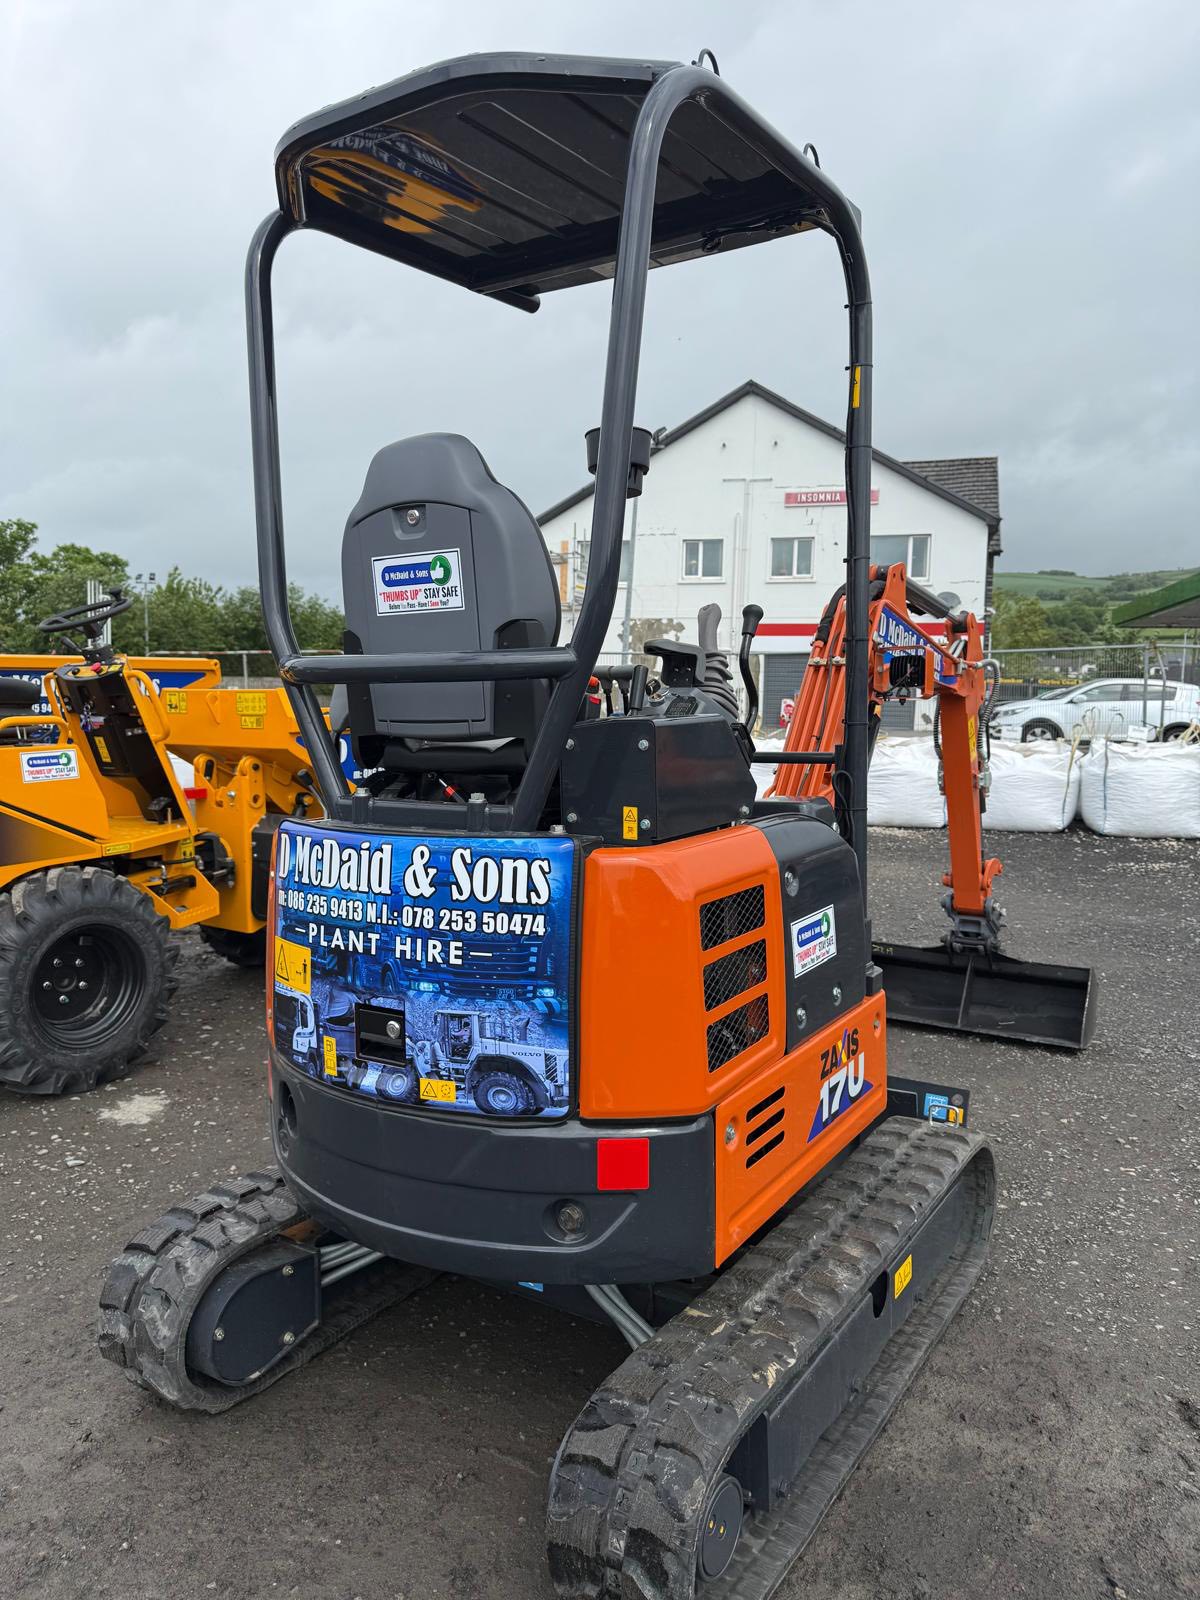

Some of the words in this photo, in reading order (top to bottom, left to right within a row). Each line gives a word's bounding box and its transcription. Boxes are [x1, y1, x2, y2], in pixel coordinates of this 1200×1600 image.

[797, 493, 840, 503] INSOMNIA
[379, 590, 409, 602] "THUMBS
[410, 588, 422, 600] UP"
[424, 588, 440, 600] STAY
[442, 586, 458, 598] SAFE
[384, 572, 389, 580] D
[390, 570, 409, 580] McDaid
[410, 570, 414, 578] &
[416, 569, 429, 578] Sons
[880, 612, 887, 637] D
[888, 618, 916, 646] McDaid
[278, 833, 290, 879] D
[294, 835, 392, 895] McDaid
[404, 845, 438, 898] &
[451, 848, 550, 905] Sons
[288, 889, 304, 911] 086
[306, 893, 328, 916] 235
[330, 897, 362, 922] 9413
[366, 902, 398, 926] N.I.:
[402, 906, 434, 929] 078
[439, 909, 476, 932] 253
[482, 912, 546, 936] 50474
[308, 922, 380, 956] PLANT
[395, 936, 463, 965] HIRE
[820, 1028, 859, 1080] ZAXIS
[820, 1052, 865, 1122] 17U
